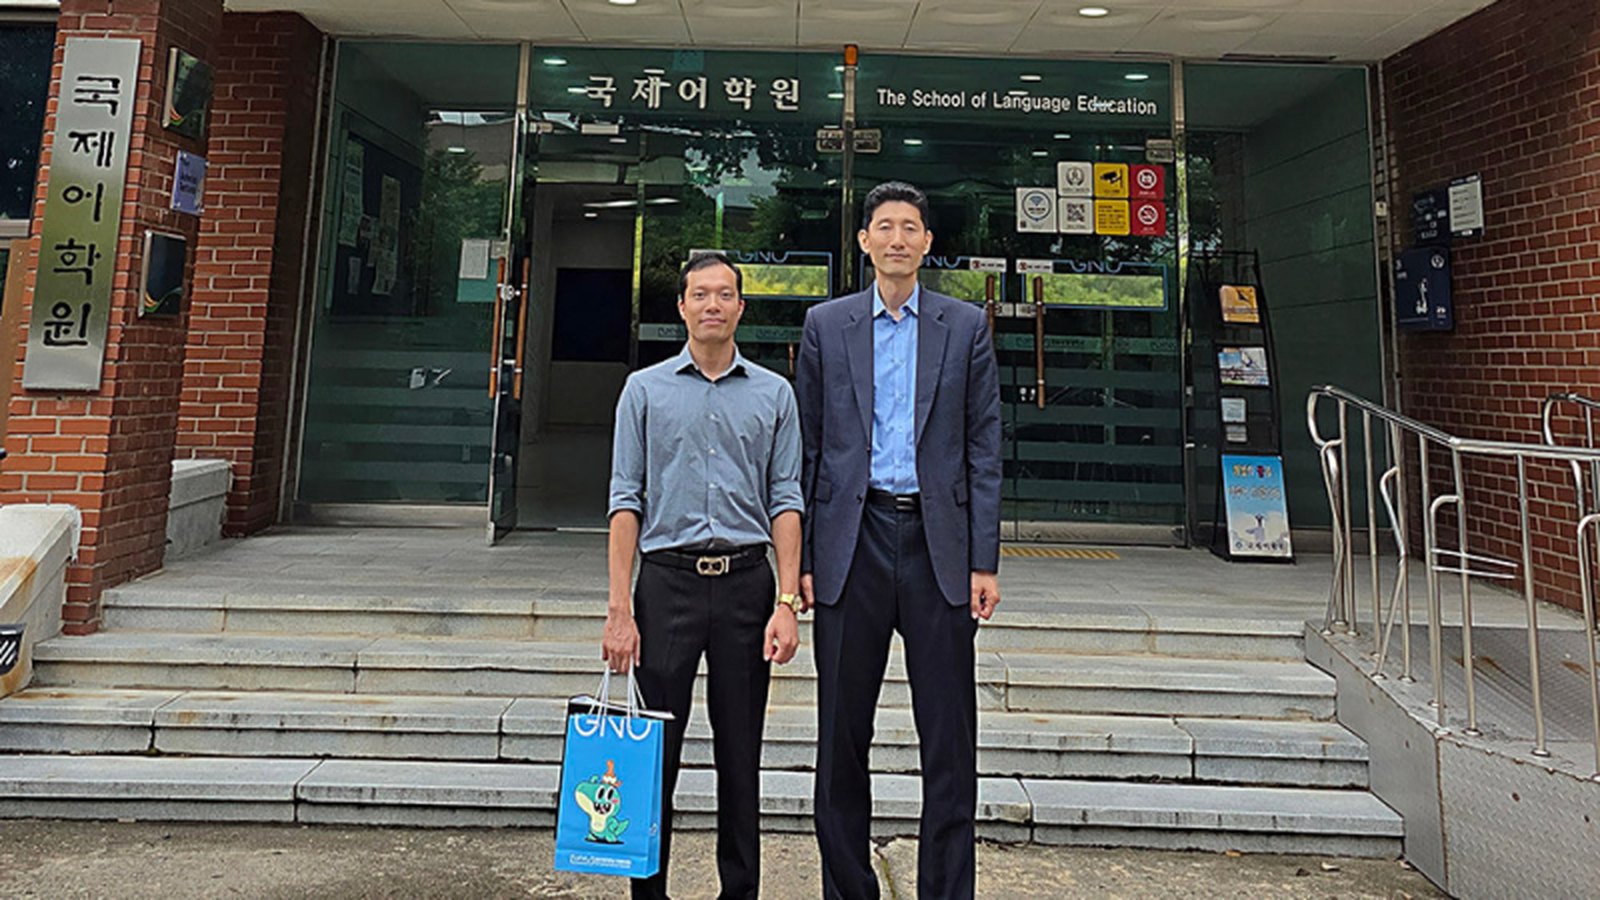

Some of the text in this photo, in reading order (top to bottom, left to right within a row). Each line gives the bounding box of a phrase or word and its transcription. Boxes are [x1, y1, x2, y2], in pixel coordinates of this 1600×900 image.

[586, 75, 799, 111] 국제어학원
[876, 88, 1157, 115] The School of Language Education
[43, 75, 121, 347] 국제어학원
[1070, 259, 1122, 274] GNU
[574, 714, 652, 741] GNU
